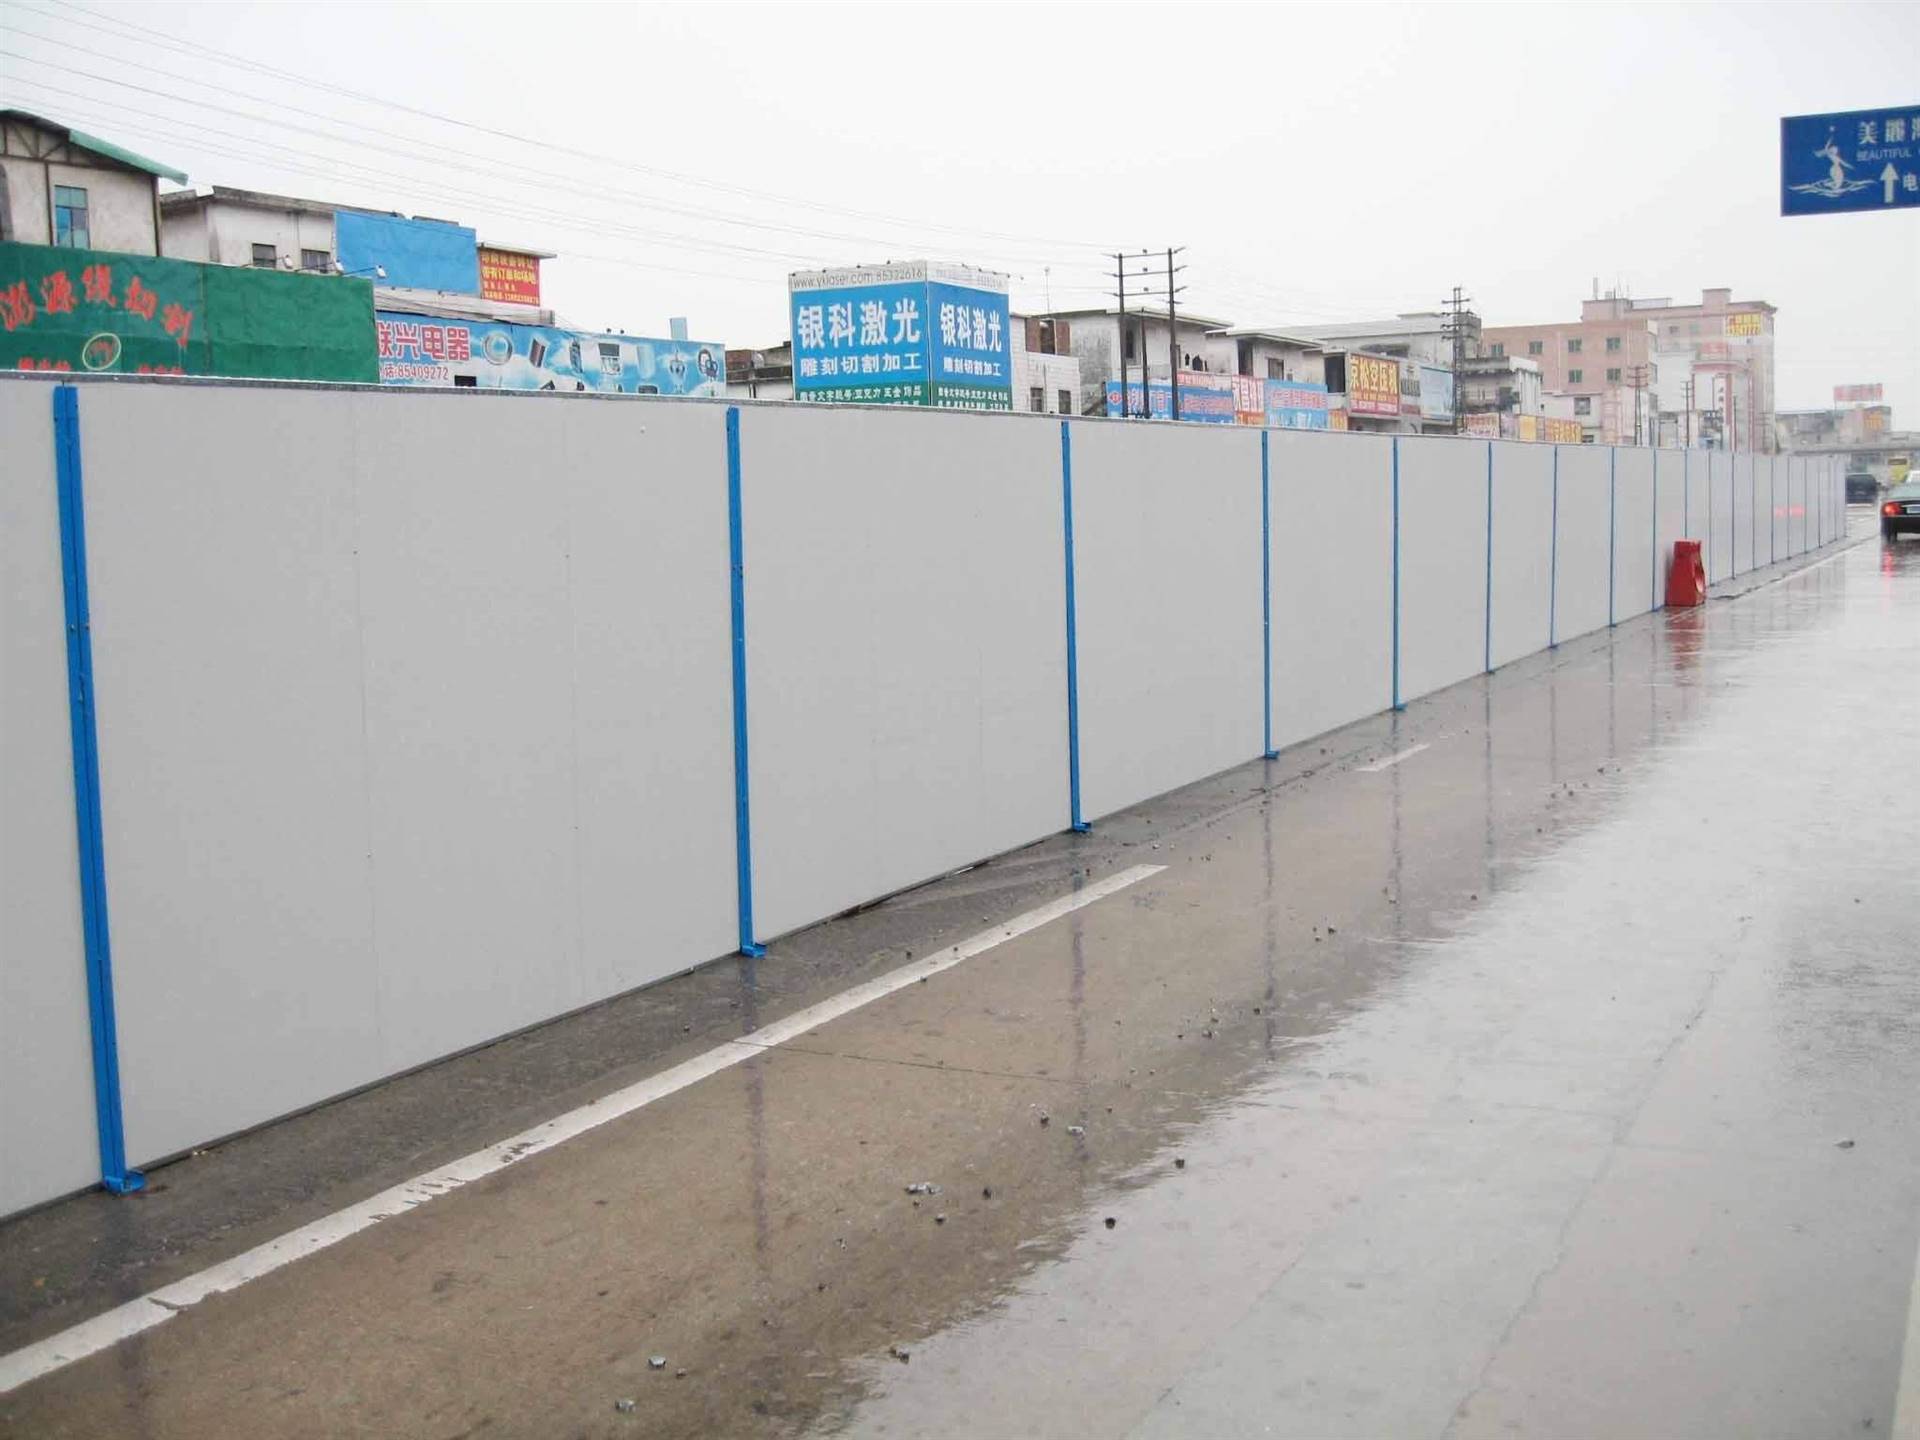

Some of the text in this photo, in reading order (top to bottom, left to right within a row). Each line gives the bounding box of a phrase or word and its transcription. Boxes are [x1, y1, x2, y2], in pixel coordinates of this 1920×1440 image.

[1856, 148, 1912, 161] BEAUTIFUL
[797, 298, 921, 350] 银科激光
[940, 302, 1002, 353] 银科激光
[800, 352, 922, 377] 雕刻切割加工
[943, 357, 1002, 377] 雕刻切割加工
